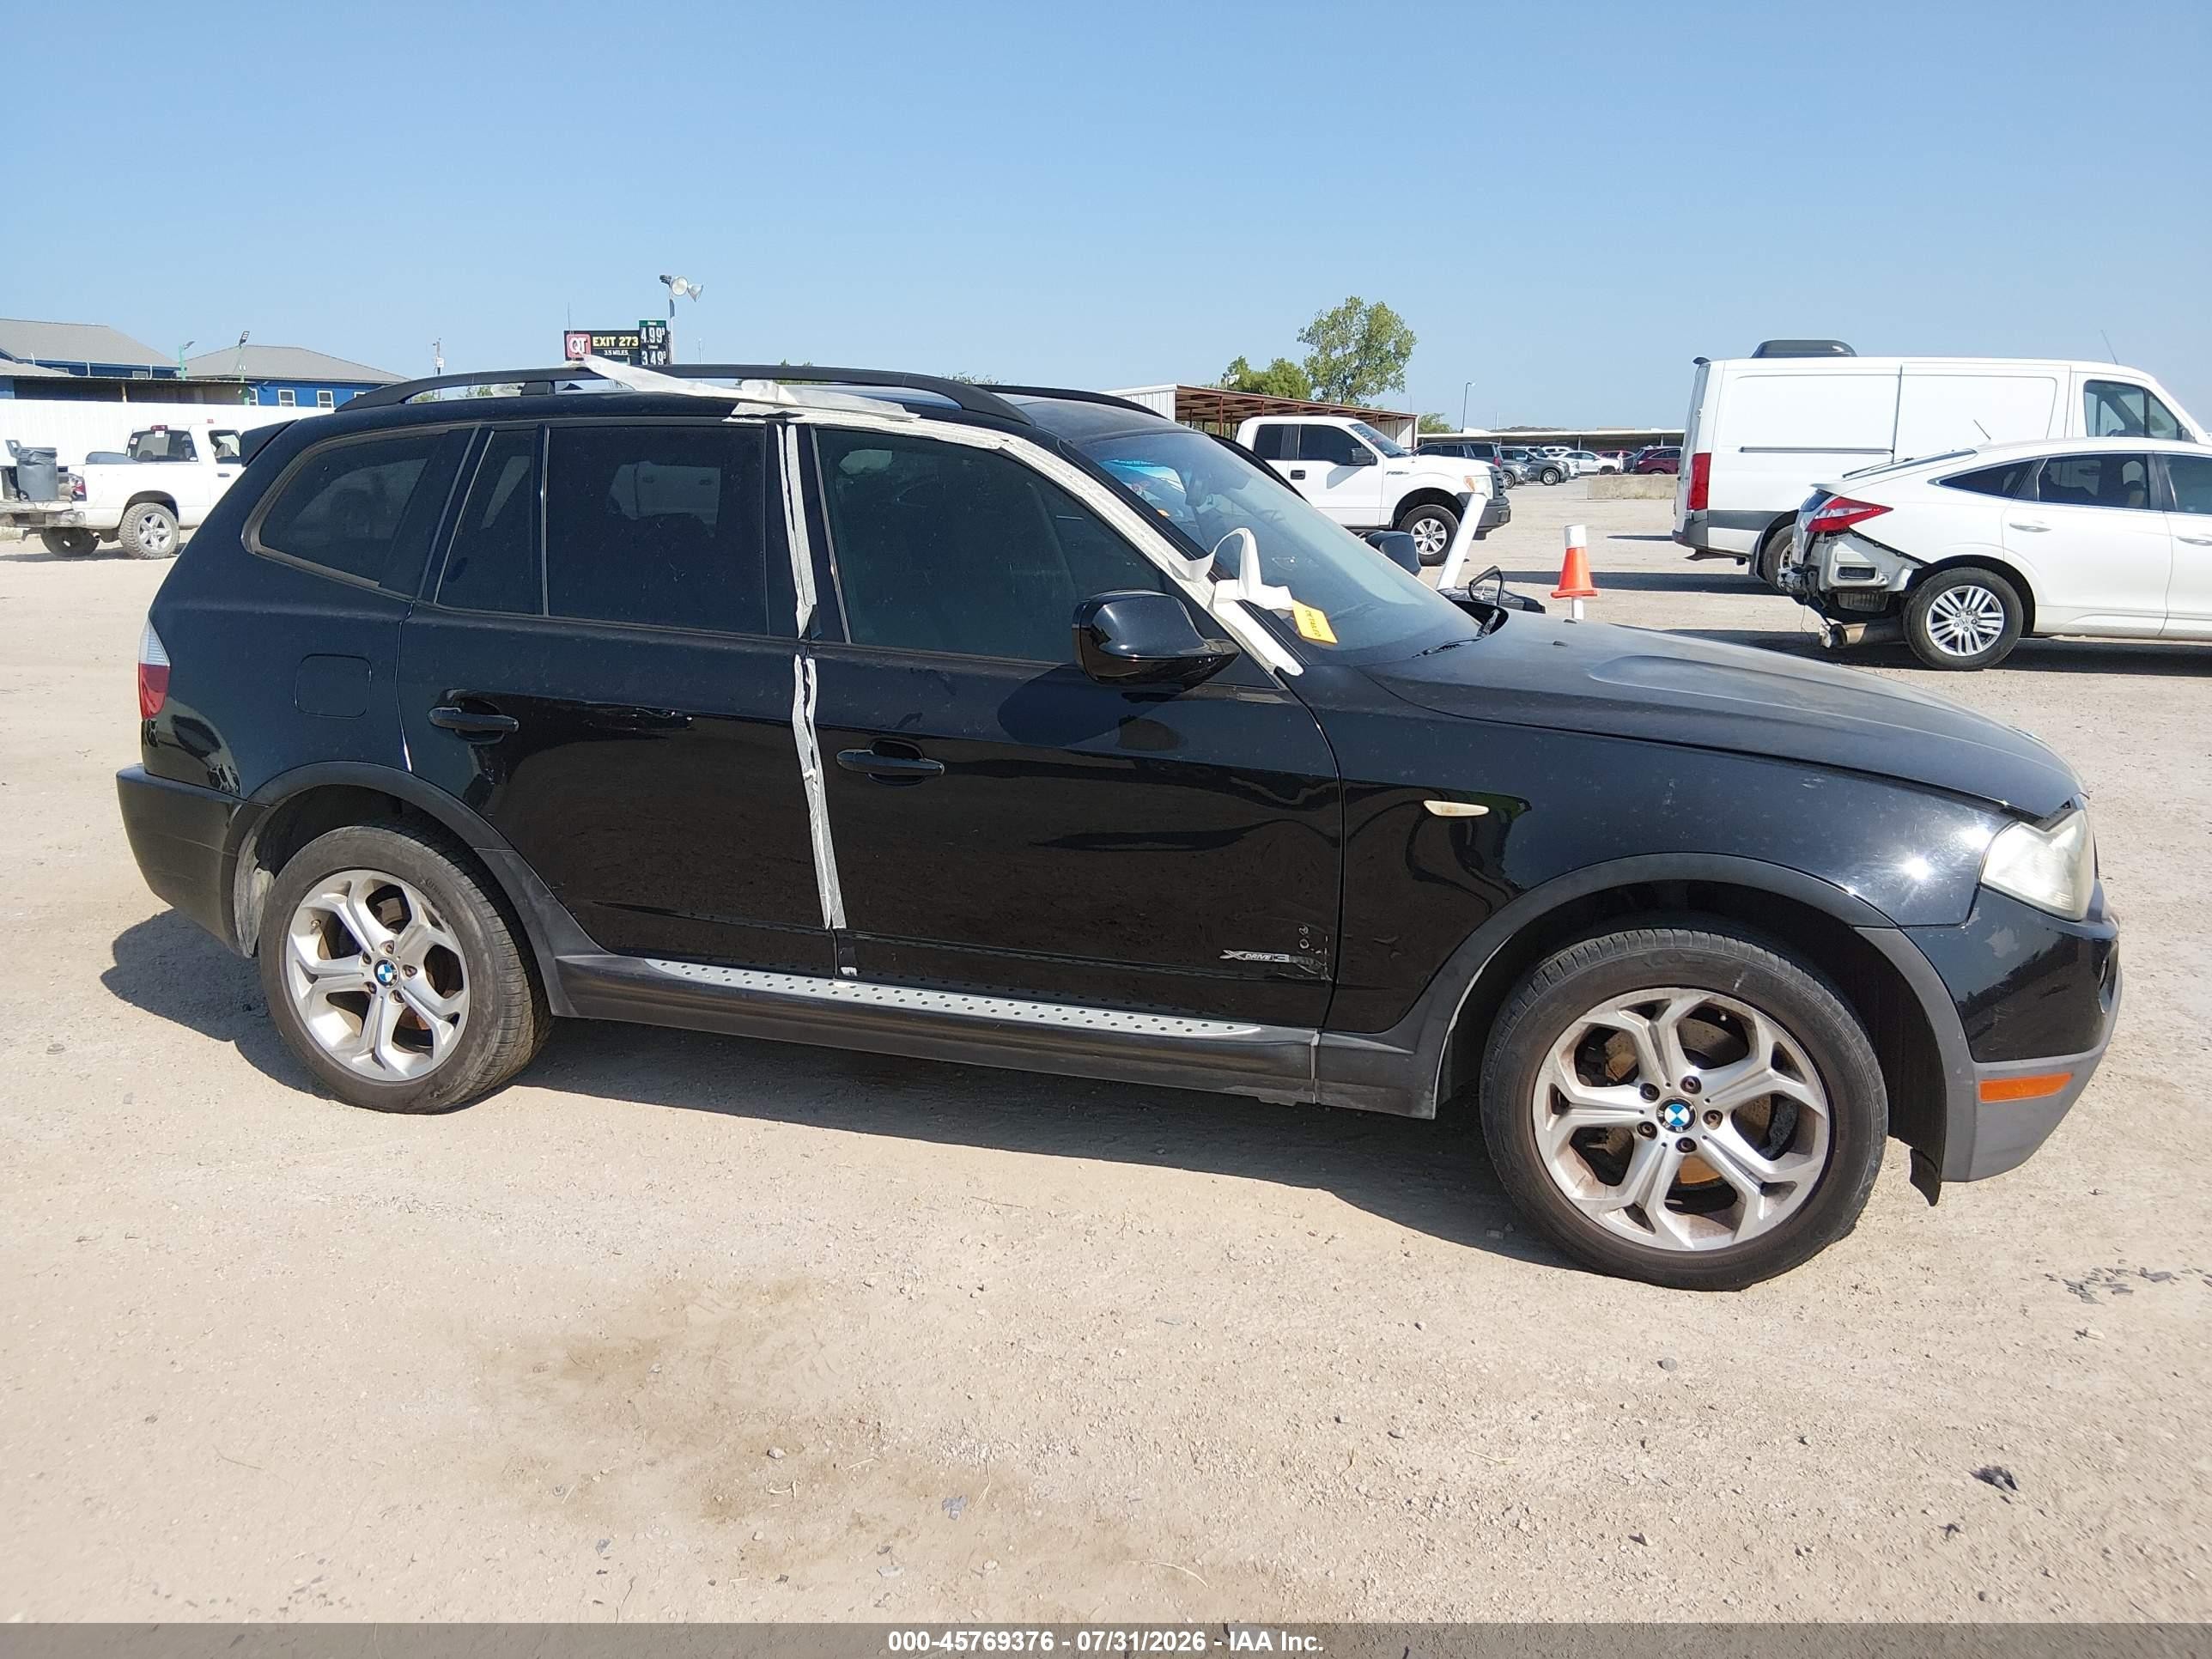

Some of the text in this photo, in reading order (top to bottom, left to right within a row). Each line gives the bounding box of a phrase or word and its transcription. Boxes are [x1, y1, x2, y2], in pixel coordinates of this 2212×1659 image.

[569, 337, 586, 353] QT
[592, 337, 639, 347] EXIT 273
